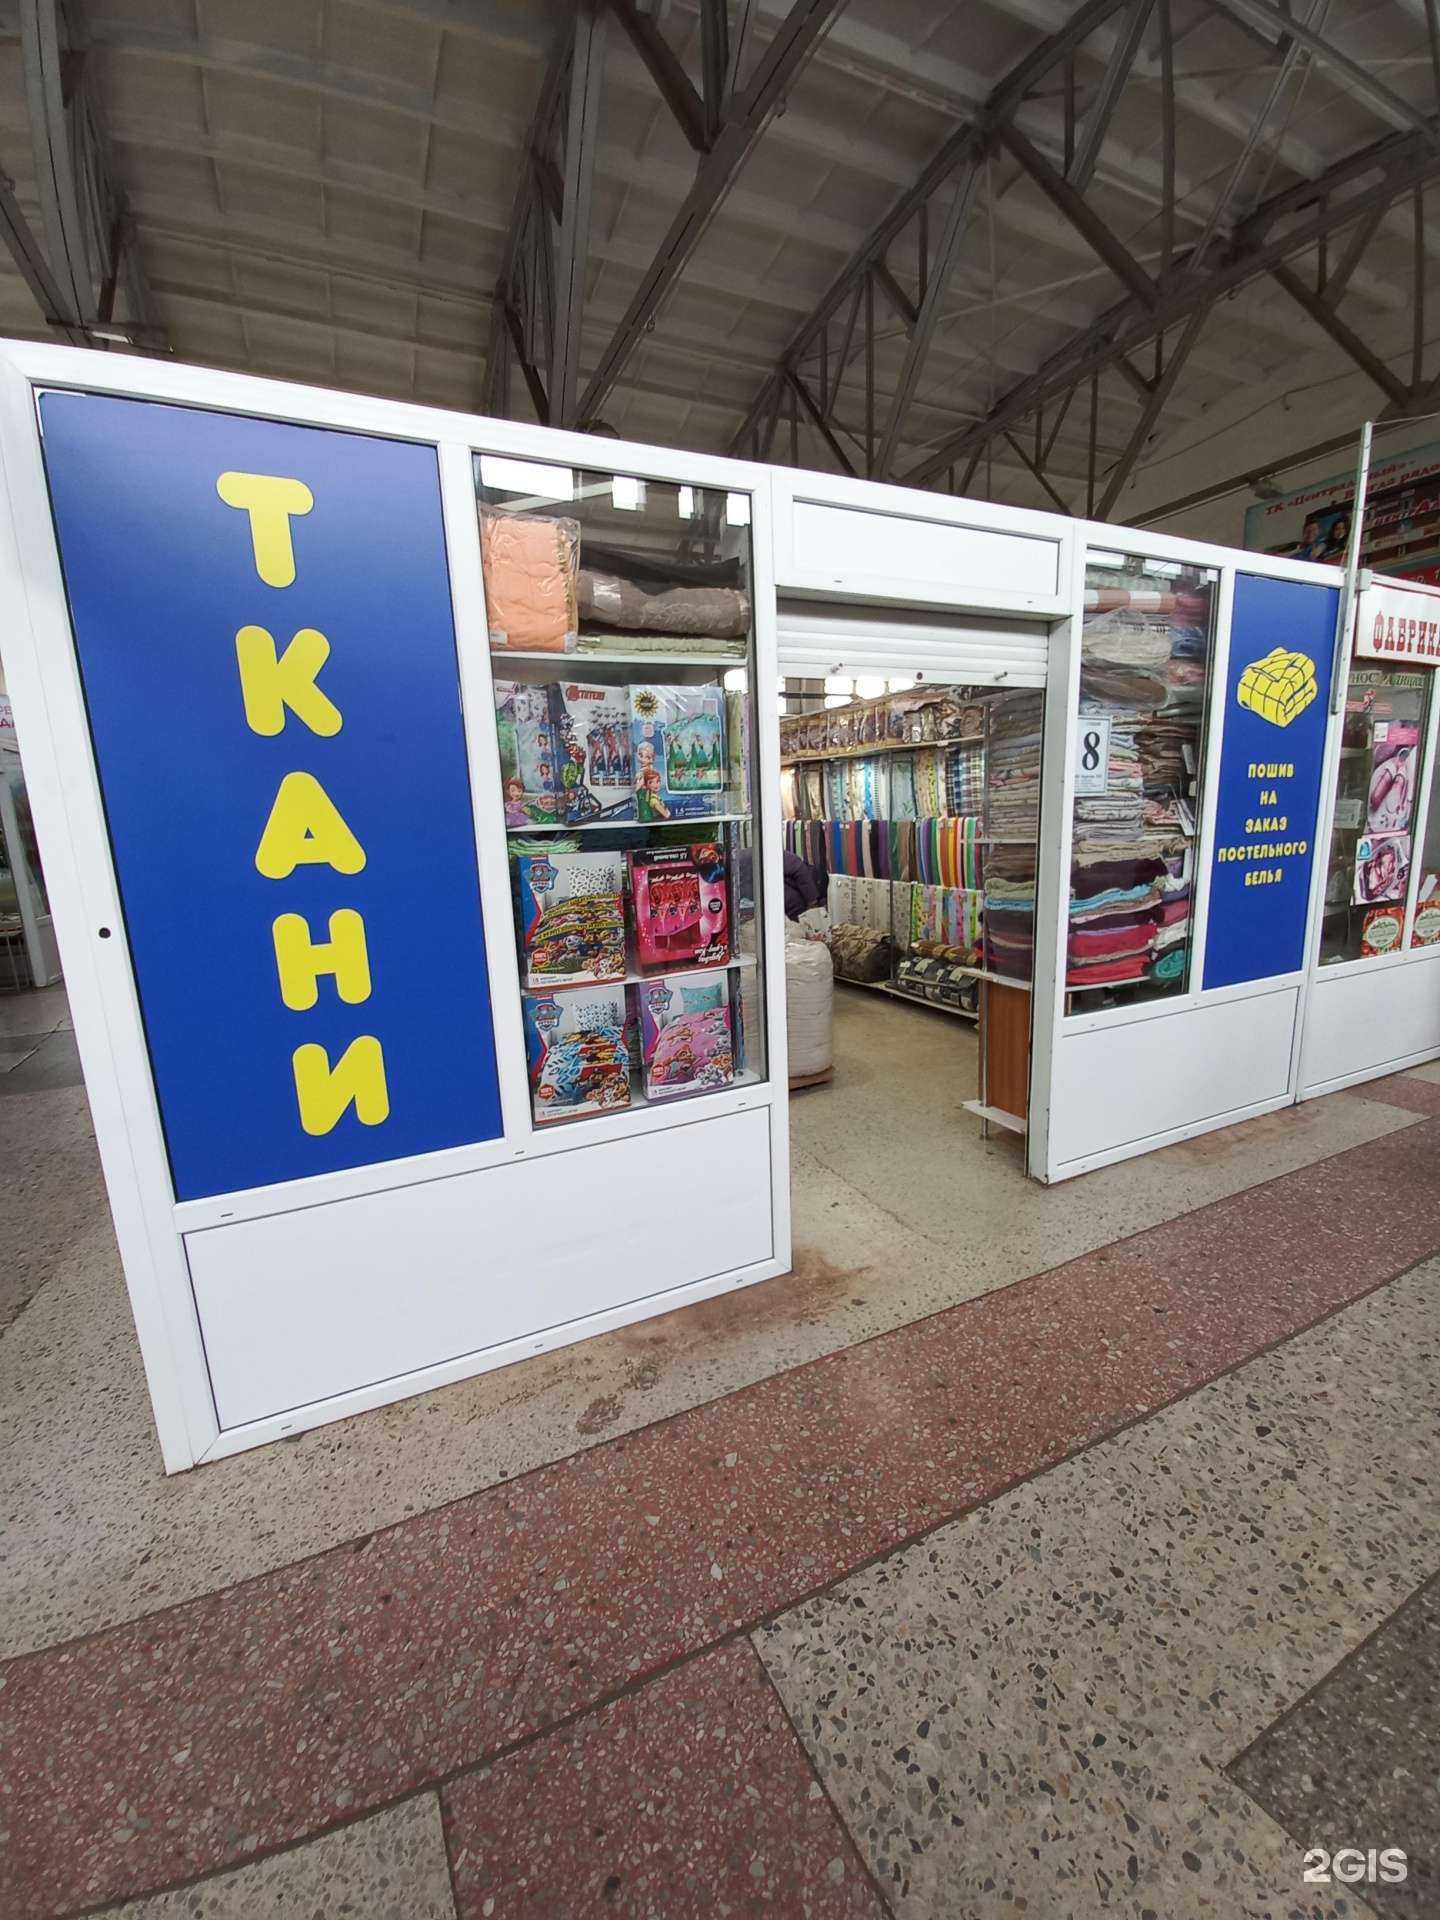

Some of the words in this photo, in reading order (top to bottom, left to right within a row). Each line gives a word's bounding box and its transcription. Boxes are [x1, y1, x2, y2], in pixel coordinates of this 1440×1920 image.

[1082, 731, 1100, 771] 8
[1248, 763, 1294, 778] ПОШИВ
[216, 471, 390, 1136] ТКАНИ
[1260, 790, 1277, 805] НА
[1245, 816, 1288, 833] ЗАКАЗ
[1218, 840, 1307, 862] ПОСТЕЛЬНОГО
[1244, 868, 1282, 886] БЕЛЬЯ
